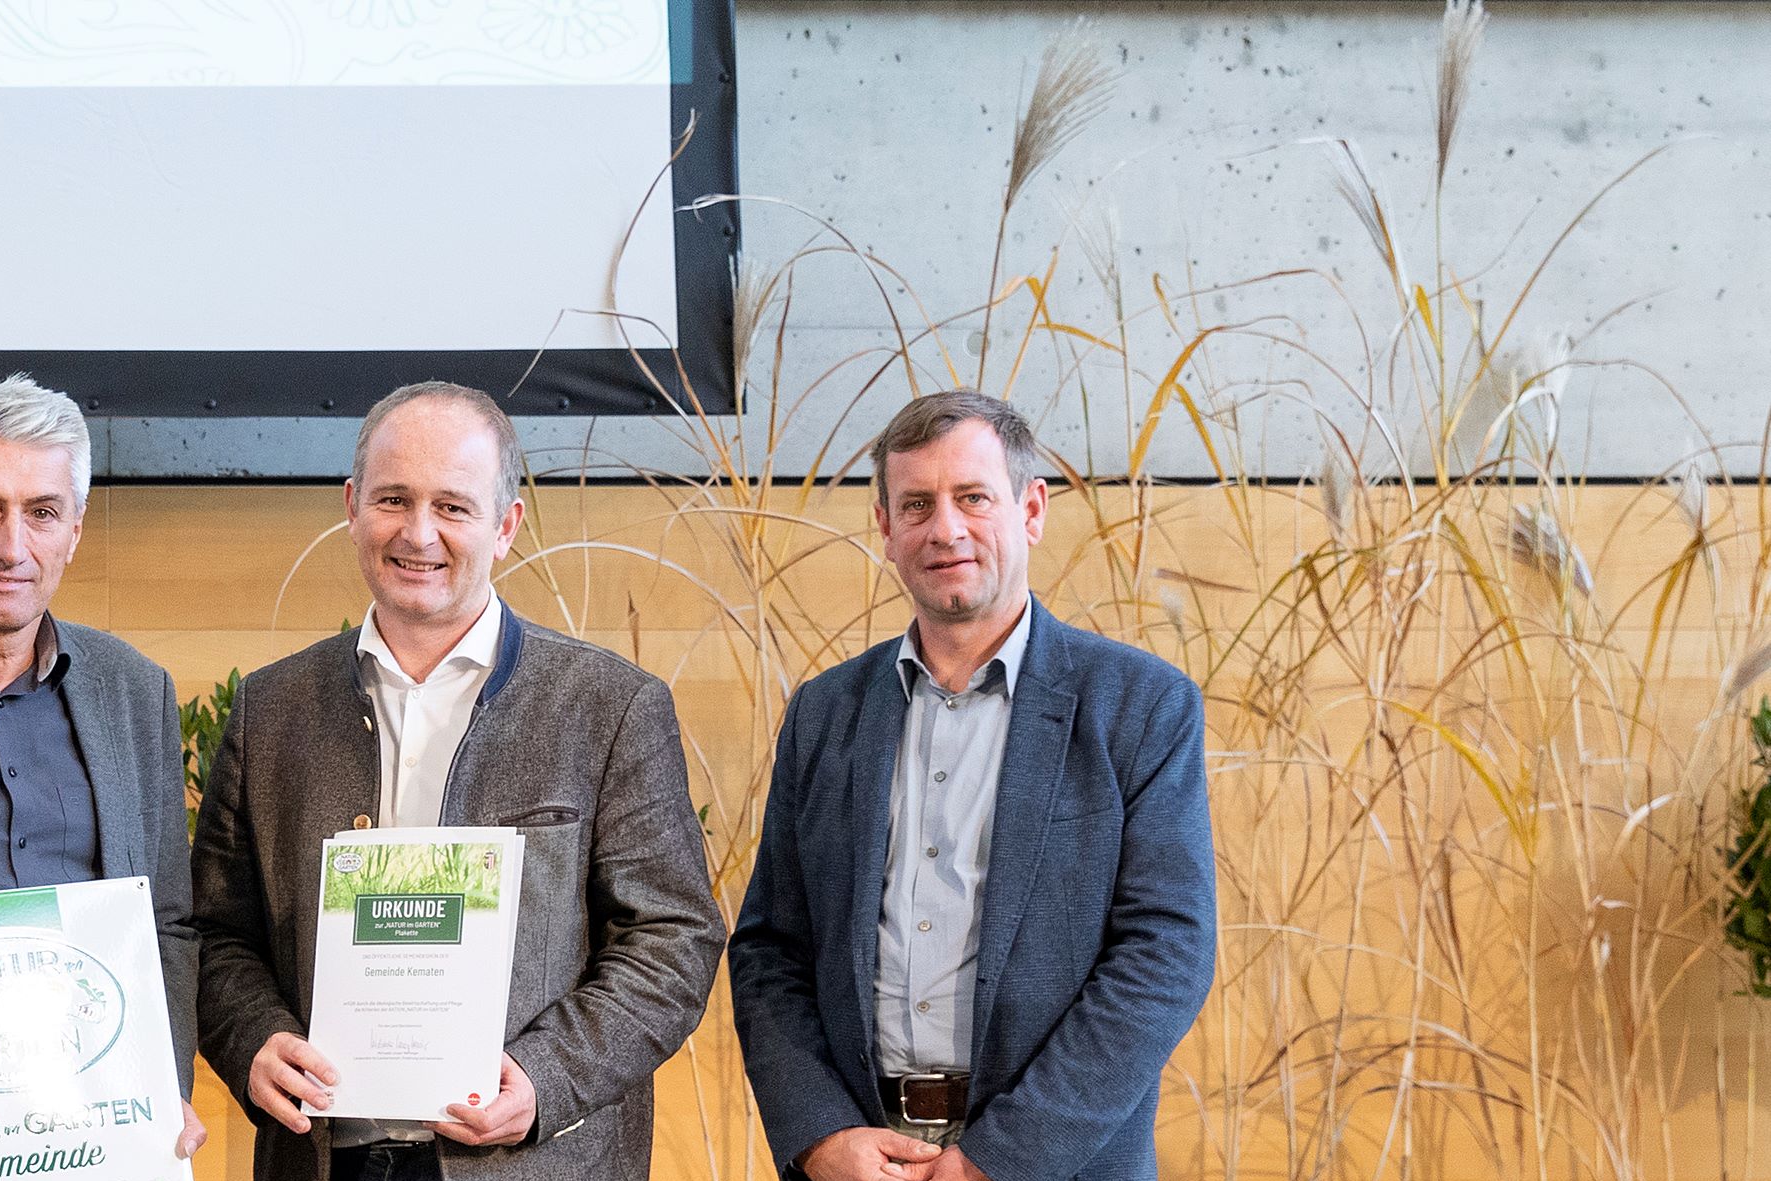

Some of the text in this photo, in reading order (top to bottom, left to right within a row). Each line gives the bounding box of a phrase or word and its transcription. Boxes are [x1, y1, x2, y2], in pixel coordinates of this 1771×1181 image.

[371, 900, 447, 918] URKUNDE
[394, 929, 419, 937] Plakette
[364, 966, 445, 977] Gemeinde Kematen
